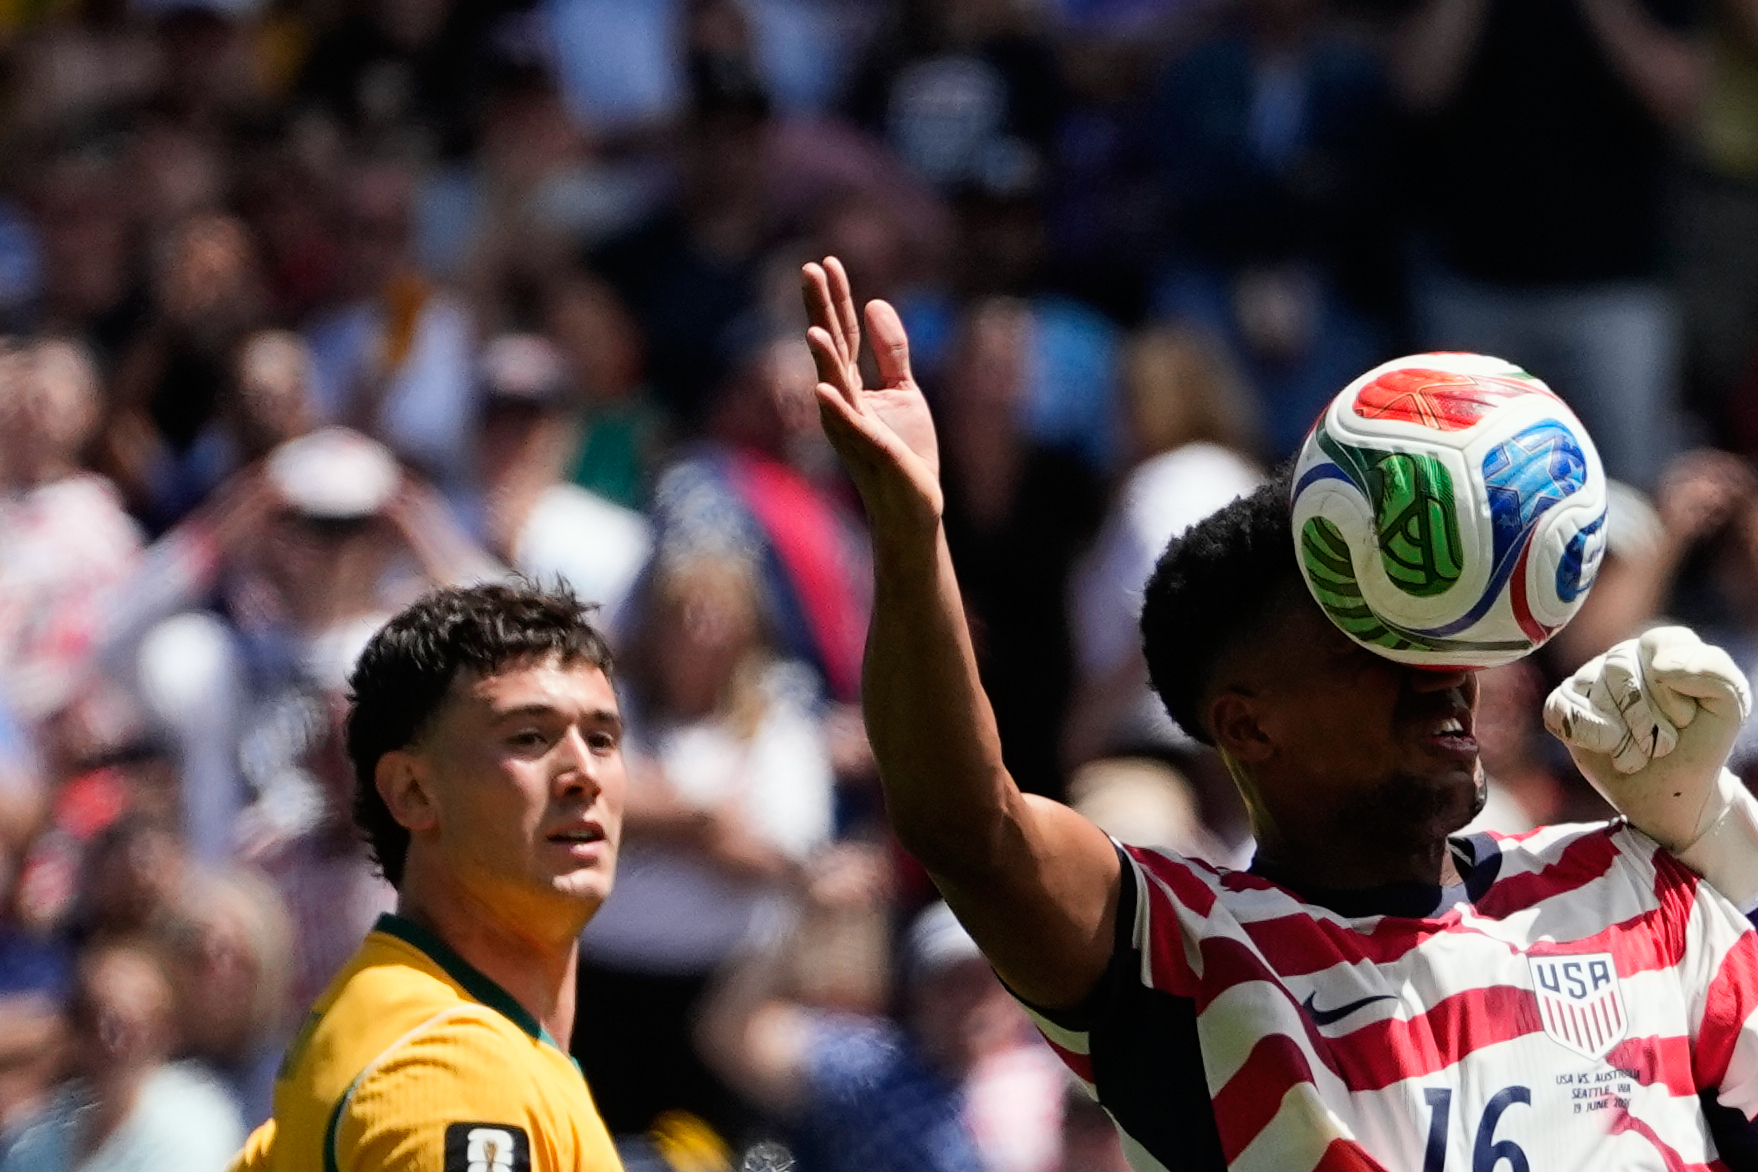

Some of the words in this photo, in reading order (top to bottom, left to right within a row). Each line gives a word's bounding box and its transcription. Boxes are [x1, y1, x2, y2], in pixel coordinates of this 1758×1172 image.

[1536, 960, 1611, 1000] USA
[1556, 1073, 1573, 1085] USA
[1617, 1083, 1631, 1094] WA
[1573, 1102, 1582, 1114] 19
[1586, 1098, 1609, 1112] JUNE
